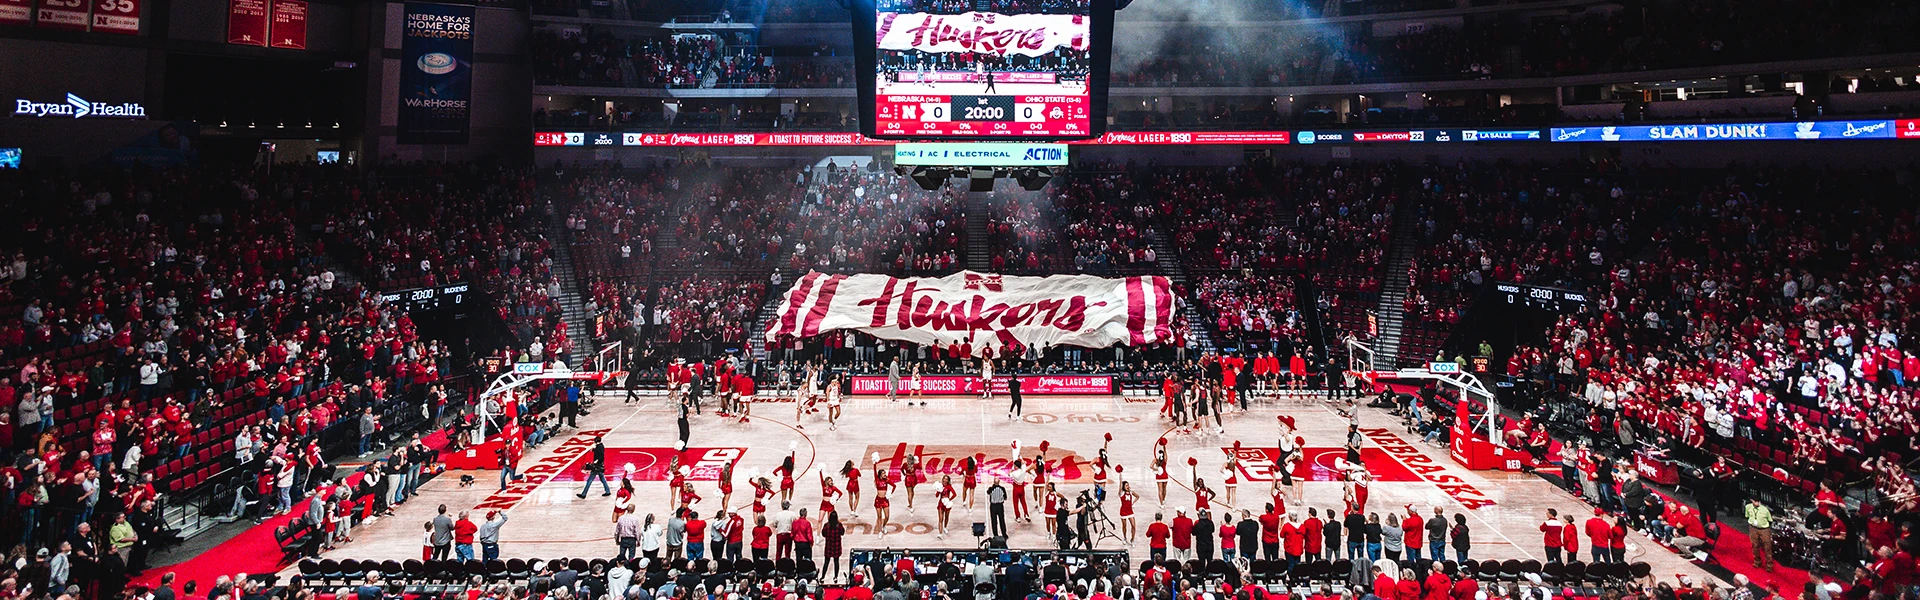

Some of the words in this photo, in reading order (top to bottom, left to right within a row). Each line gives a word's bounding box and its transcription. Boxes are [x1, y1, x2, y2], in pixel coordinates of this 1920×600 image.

[408, 14, 470, 23] NEBRASKA'S
[408, 21, 443, 30] HOME
[447, 23, 470, 31] FOR
[408, 29, 470, 40] JACKPOTS
[906, 15, 1046, 55] Huskers
[16, 99, 73, 117] Bryan
[91, 102, 145, 116] Health
[934, 107, 943, 118] 0
[965, 107, 1004, 119] 20:00
[1024, 107, 1032, 119] 0
[1650, 126, 1698, 139] SLAM
[1706, 124, 1767, 138] DUNK!
[572, 135, 580, 143] 0
[703, 135, 729, 144] LAGER
[734, 135, 754, 144] 1890
[769, 135, 774, 144] A
[774, 135, 792, 144] TOAST
[793, 135, 800, 144] TO
[802, 135, 824, 144] FUTURE
[825, 135, 851, 144] SUCCESS
[1170, 133, 1191, 143] 1890
[1023, 148, 1062, 160] ACTION
[412, 289, 434, 300] 20:00
[444, 286, 468, 294] BUCKEYES
[1497, 285, 1519, 293] HUSKERS
[1530, 288, 1552, 300] 20:00
[456, 294, 462, 303] 0
[1508, 294, 1513, 303] 0
[858, 277, 1107, 352] Huskers
[855, 380, 860, 390] A
[861, 380, 884, 390] TOAST
[923, 380, 956, 390] SUCCESS
[1091, 378, 1108, 386] 1890
[878, 442, 1091, 484] Huskers
[1506, 460, 1521, 469] RED
[473, 428, 612, 510] NEBRASKA
[1358, 428, 1497, 510] NEBRASKA
